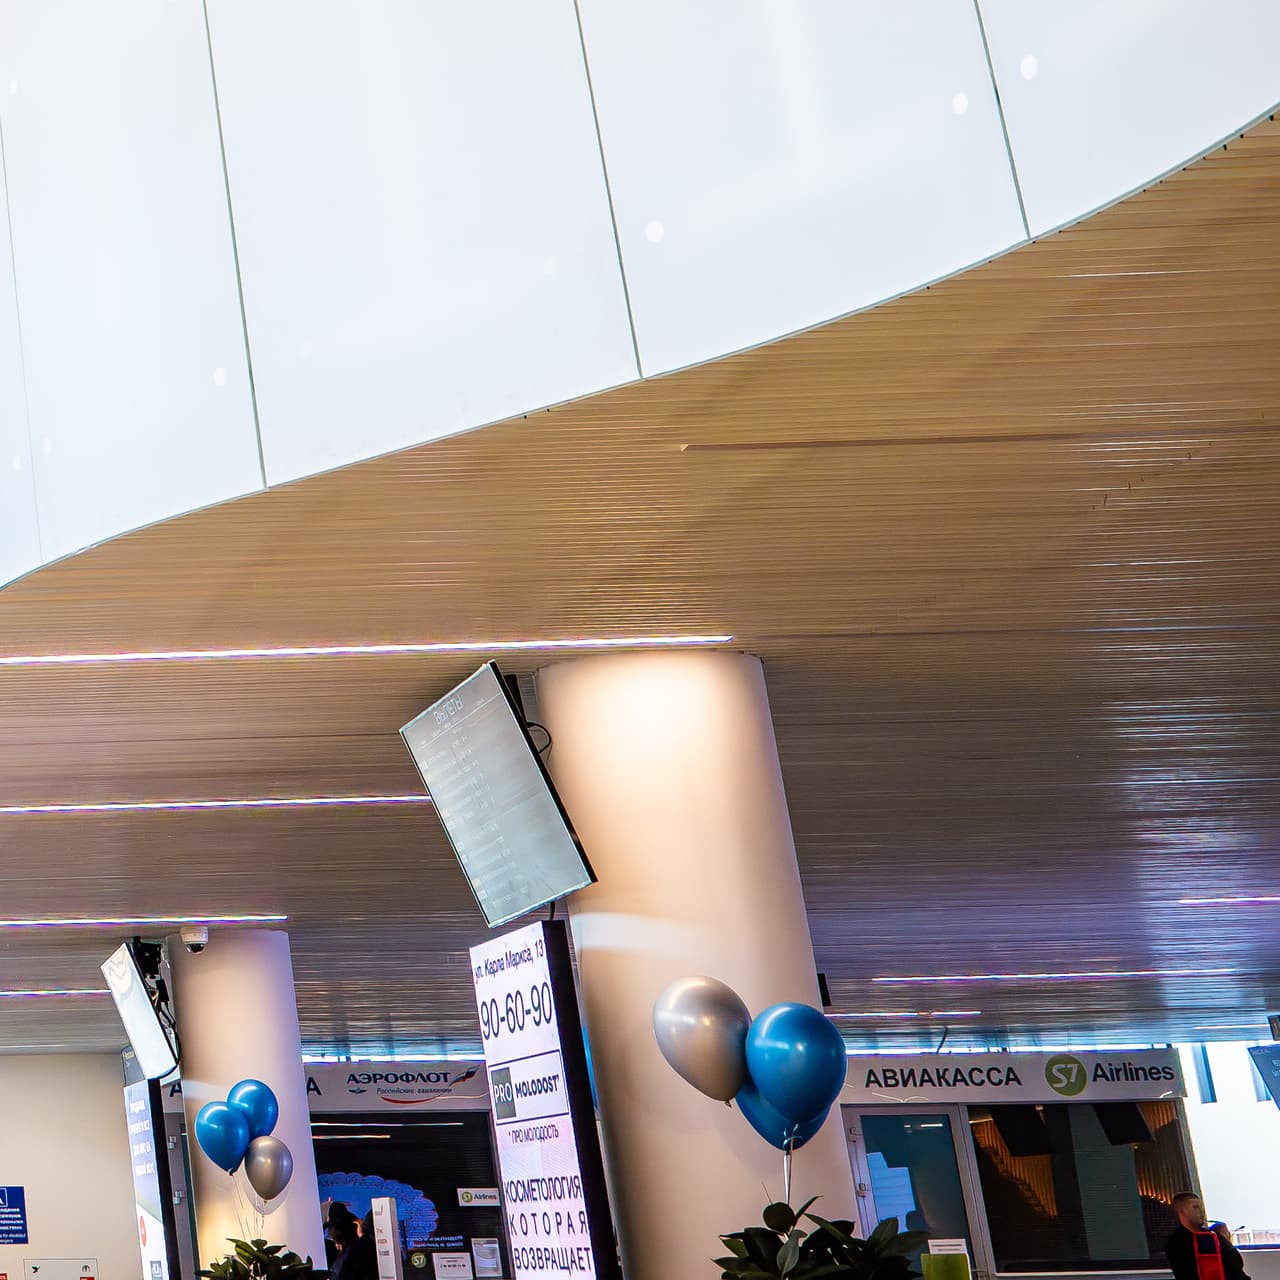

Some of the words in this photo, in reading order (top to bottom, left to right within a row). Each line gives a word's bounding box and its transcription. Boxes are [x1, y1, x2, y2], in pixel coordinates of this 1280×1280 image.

[484, 958, 505, 979] Карла
[480, 981, 552, 1041] 90-60-90
[346, 1072, 451, 1085] АЭРОФЛОТ
[864, 1066, 1023, 1089] АВИАКАССА
[1051, 1063, 1079, 1088] S7
[1092, 1061, 1175, 1083] Airlines
[493, 1082, 513, 1104] PRO
[504, 1175, 582, 1204] КОСМЕТОЛОГИЯ
[509, 1210, 588, 1236] КОТОРАЯ
[413, 1255, 425, 1266] S7
[513, 1247, 593, 1276] ВОЗВРАЩАЕТ
